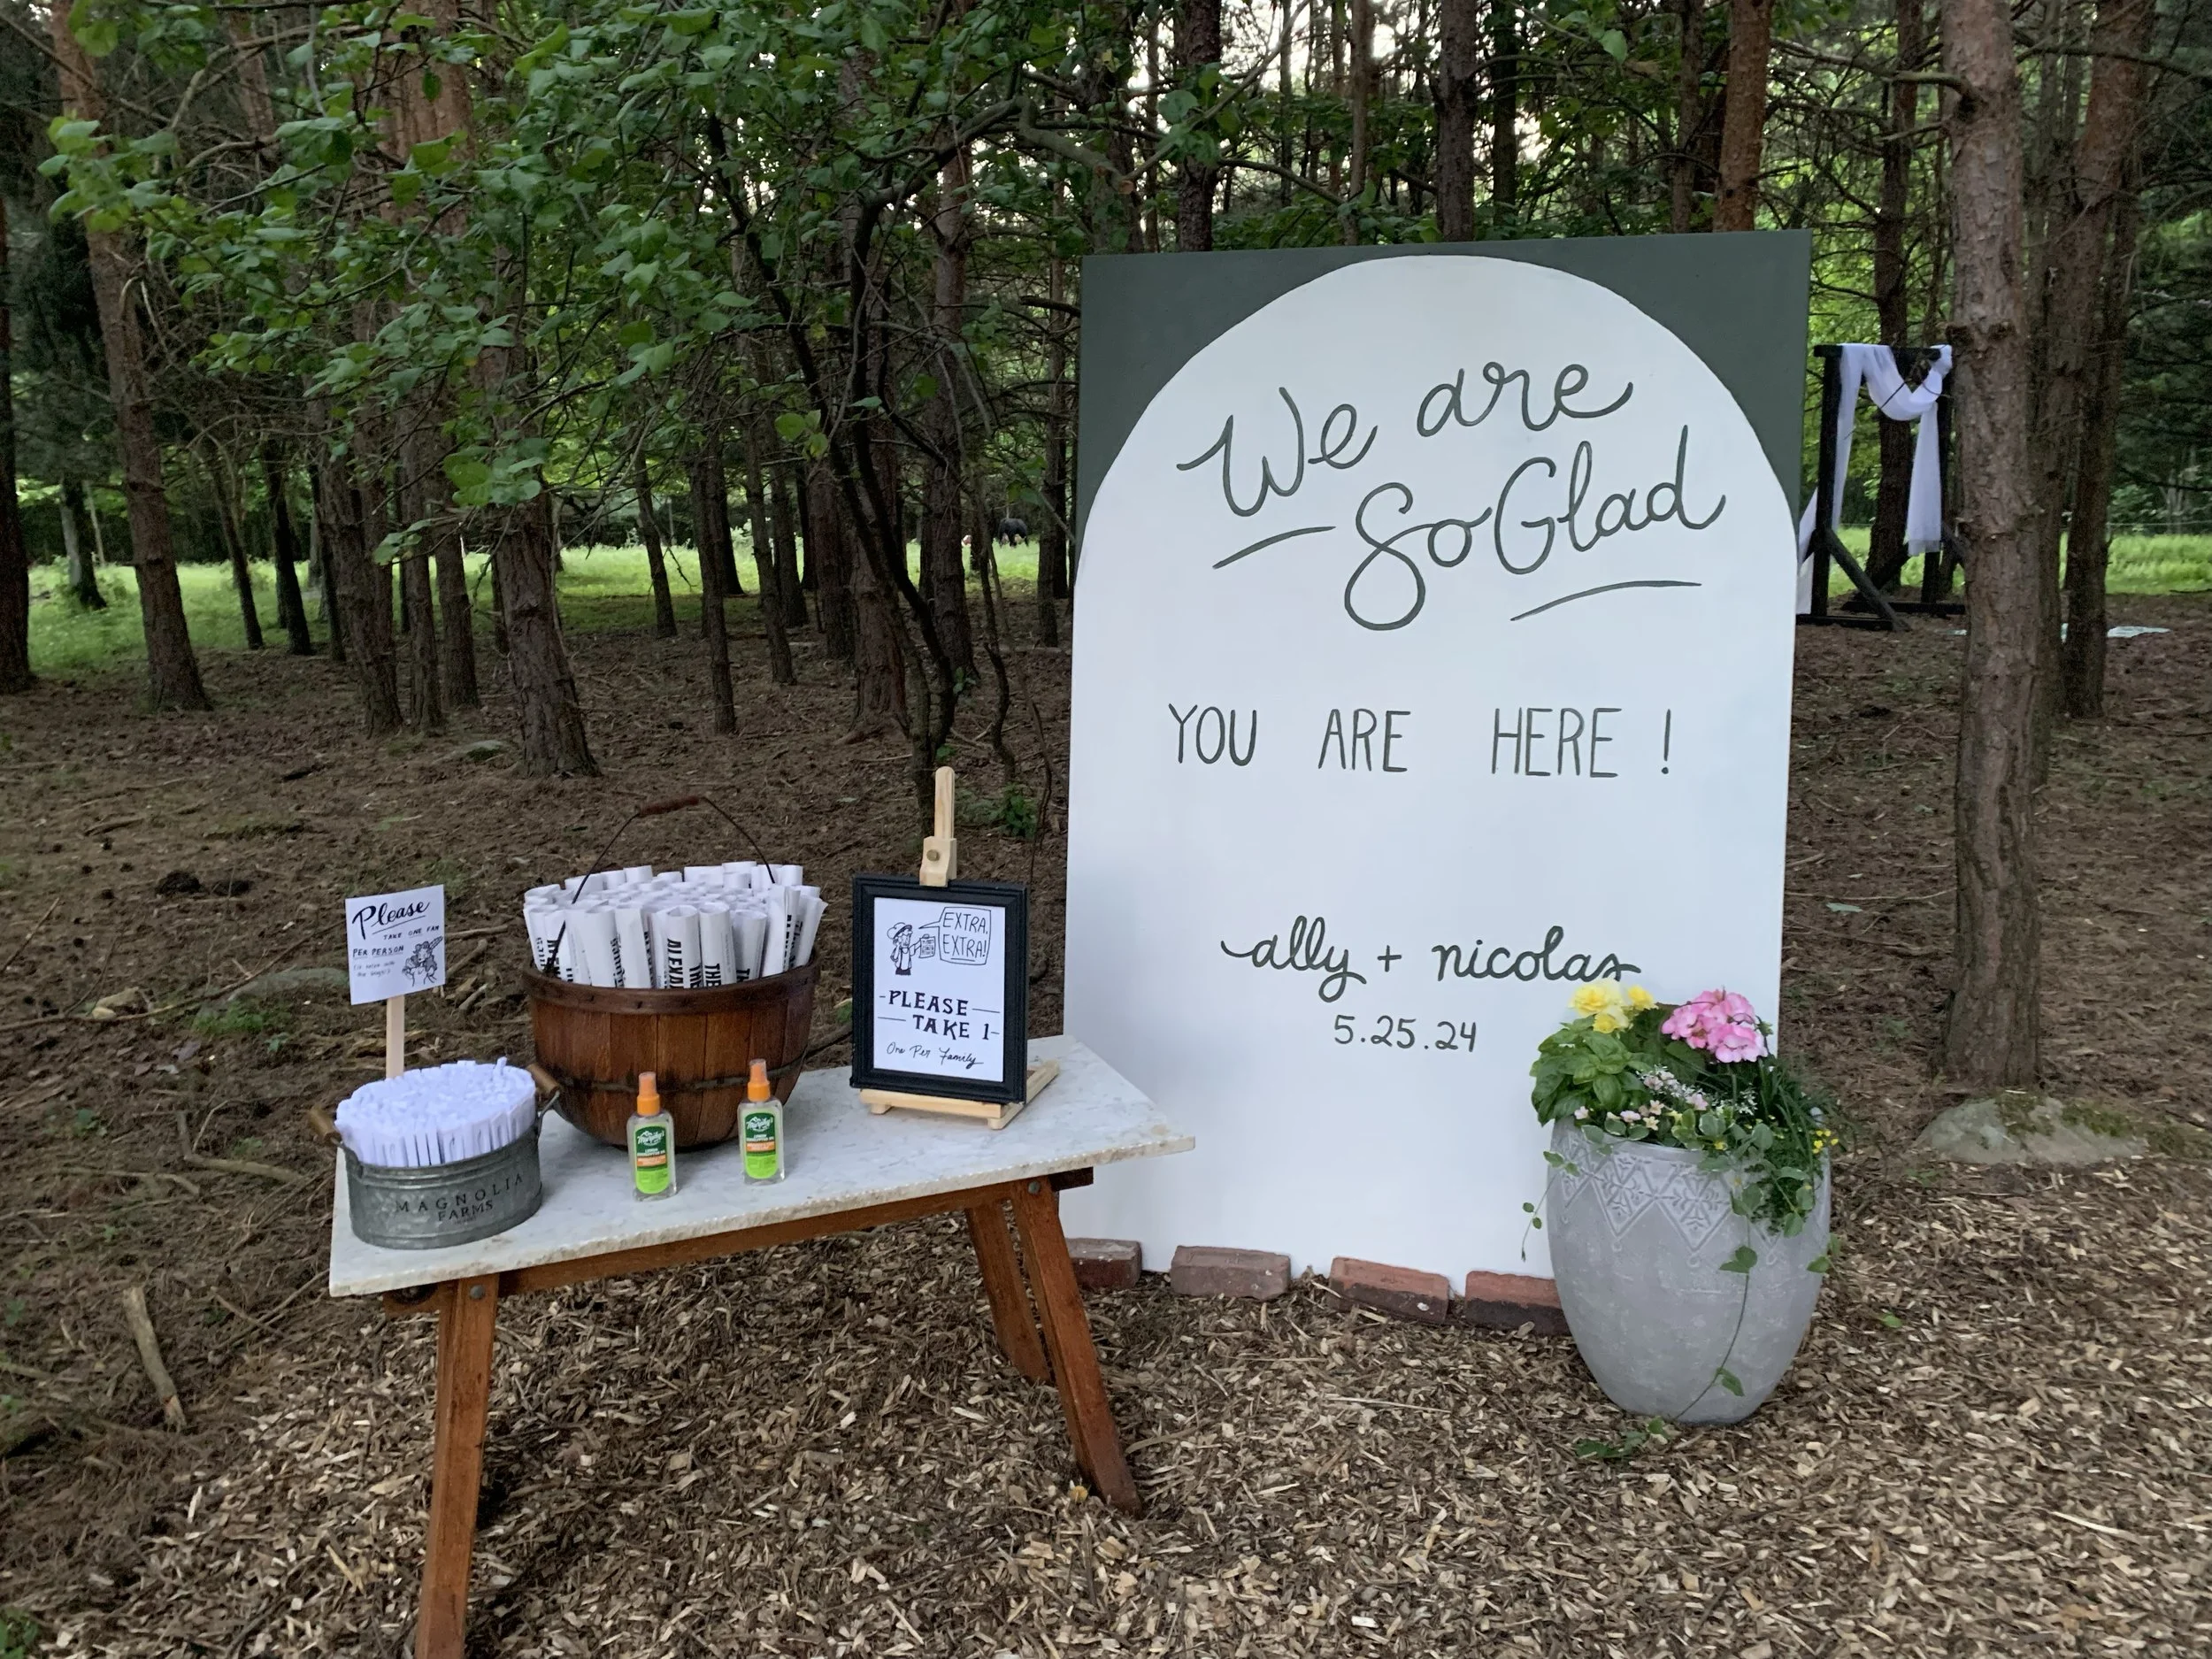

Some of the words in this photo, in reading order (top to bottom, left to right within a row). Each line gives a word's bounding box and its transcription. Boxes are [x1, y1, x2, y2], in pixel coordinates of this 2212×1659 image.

[1176, 386, 1379, 518] We
[1417, 361, 1634, 438] are
[1344, 481, 1493, 631] So
[1494, 425, 1727, 574] Glad
[1168, 703, 1257, 767] YOU
[1317, 708, 1411, 772] ARE
[1491, 708, 1622, 778] HERE
[351, 901, 431, 941] Please
[408, 927, 422, 936] ONE
[372, 945, 404, 956] PERSON
[942, 933, 987, 958] EXTRA!
[1220, 915, 1367, 1002] ally
[1431, 926, 1642, 983] nicolas
[888, 989, 969, 1017] PLEASE
[912, 1014, 970, 1041] TAKE
[1334, 1014, 1478, 1053] 5.25.24
[887, 1041, 906, 1055] One
[910, 1044, 932, 1059] Per
[938, 1047, 985, 1070] Family
[396, 1172, 524, 1213] MAGNOLIA
[438, 1200, 494, 1222] FARMS
